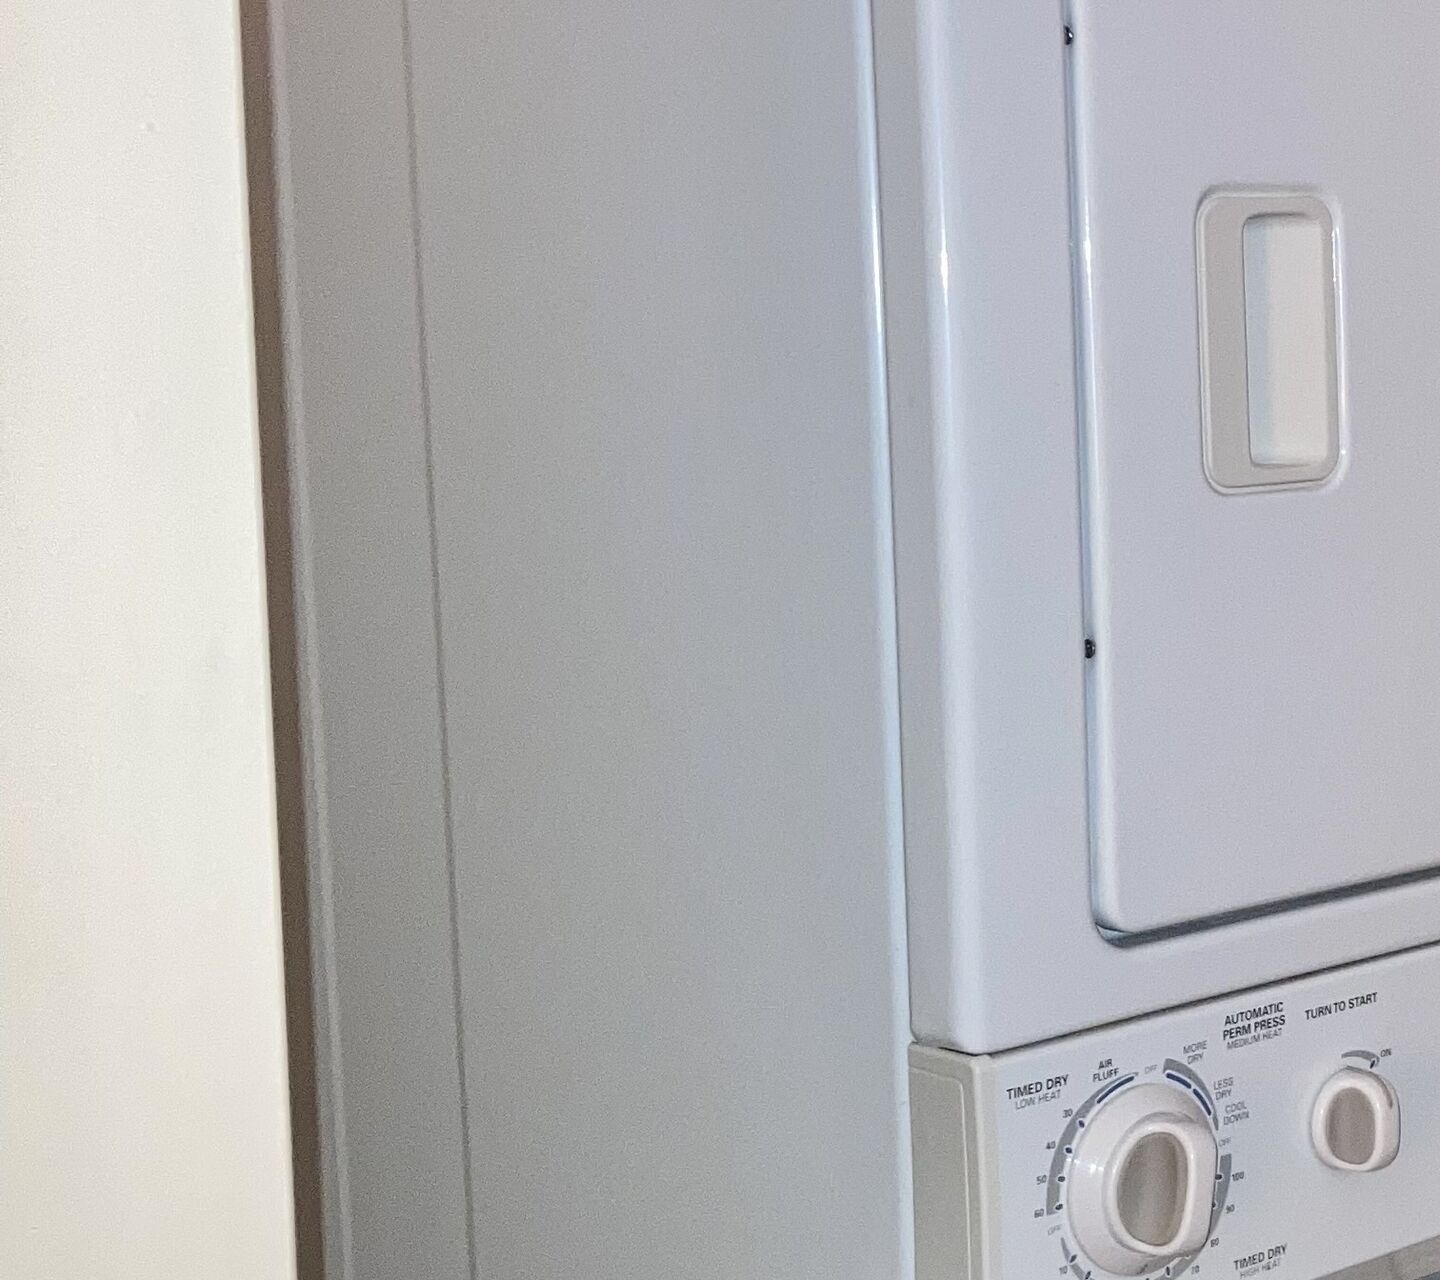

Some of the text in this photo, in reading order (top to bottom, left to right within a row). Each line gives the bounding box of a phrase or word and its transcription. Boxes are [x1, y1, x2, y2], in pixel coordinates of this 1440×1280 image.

[1304, 991, 1378, 1020] TURN TO START
[1224, 1001, 1284, 1026] AUTOMATIC
[1222, 1014, 1286, 1040] PERM PRESS
[1182, 1040, 1208, 1054] MORE
[1226, 1034, 1261, 1050] MEDIUM
[1098, 1058, 1113, 1070] AIR
[1187, 1052, 1204, 1065] DRY
[1092, 1067, 1119, 1082] FLUFF
[1006, 1074, 1070, 1100] TIMED DRY
[1213, 1077, 1234, 1091] LESS
[1015, 1089, 1062, 1110] LOW HEAT
[1215, 1088, 1233, 1101] DRY
[1062, 1108, 1074, 1119] 30
[1223, 1111, 1250, 1126] DOWN
[1036, 1174, 1048, 1185] 50
[1231, 1171, 1246, 1182] 100
[1233, 1242, 1289, 1270] TIMED DRY
